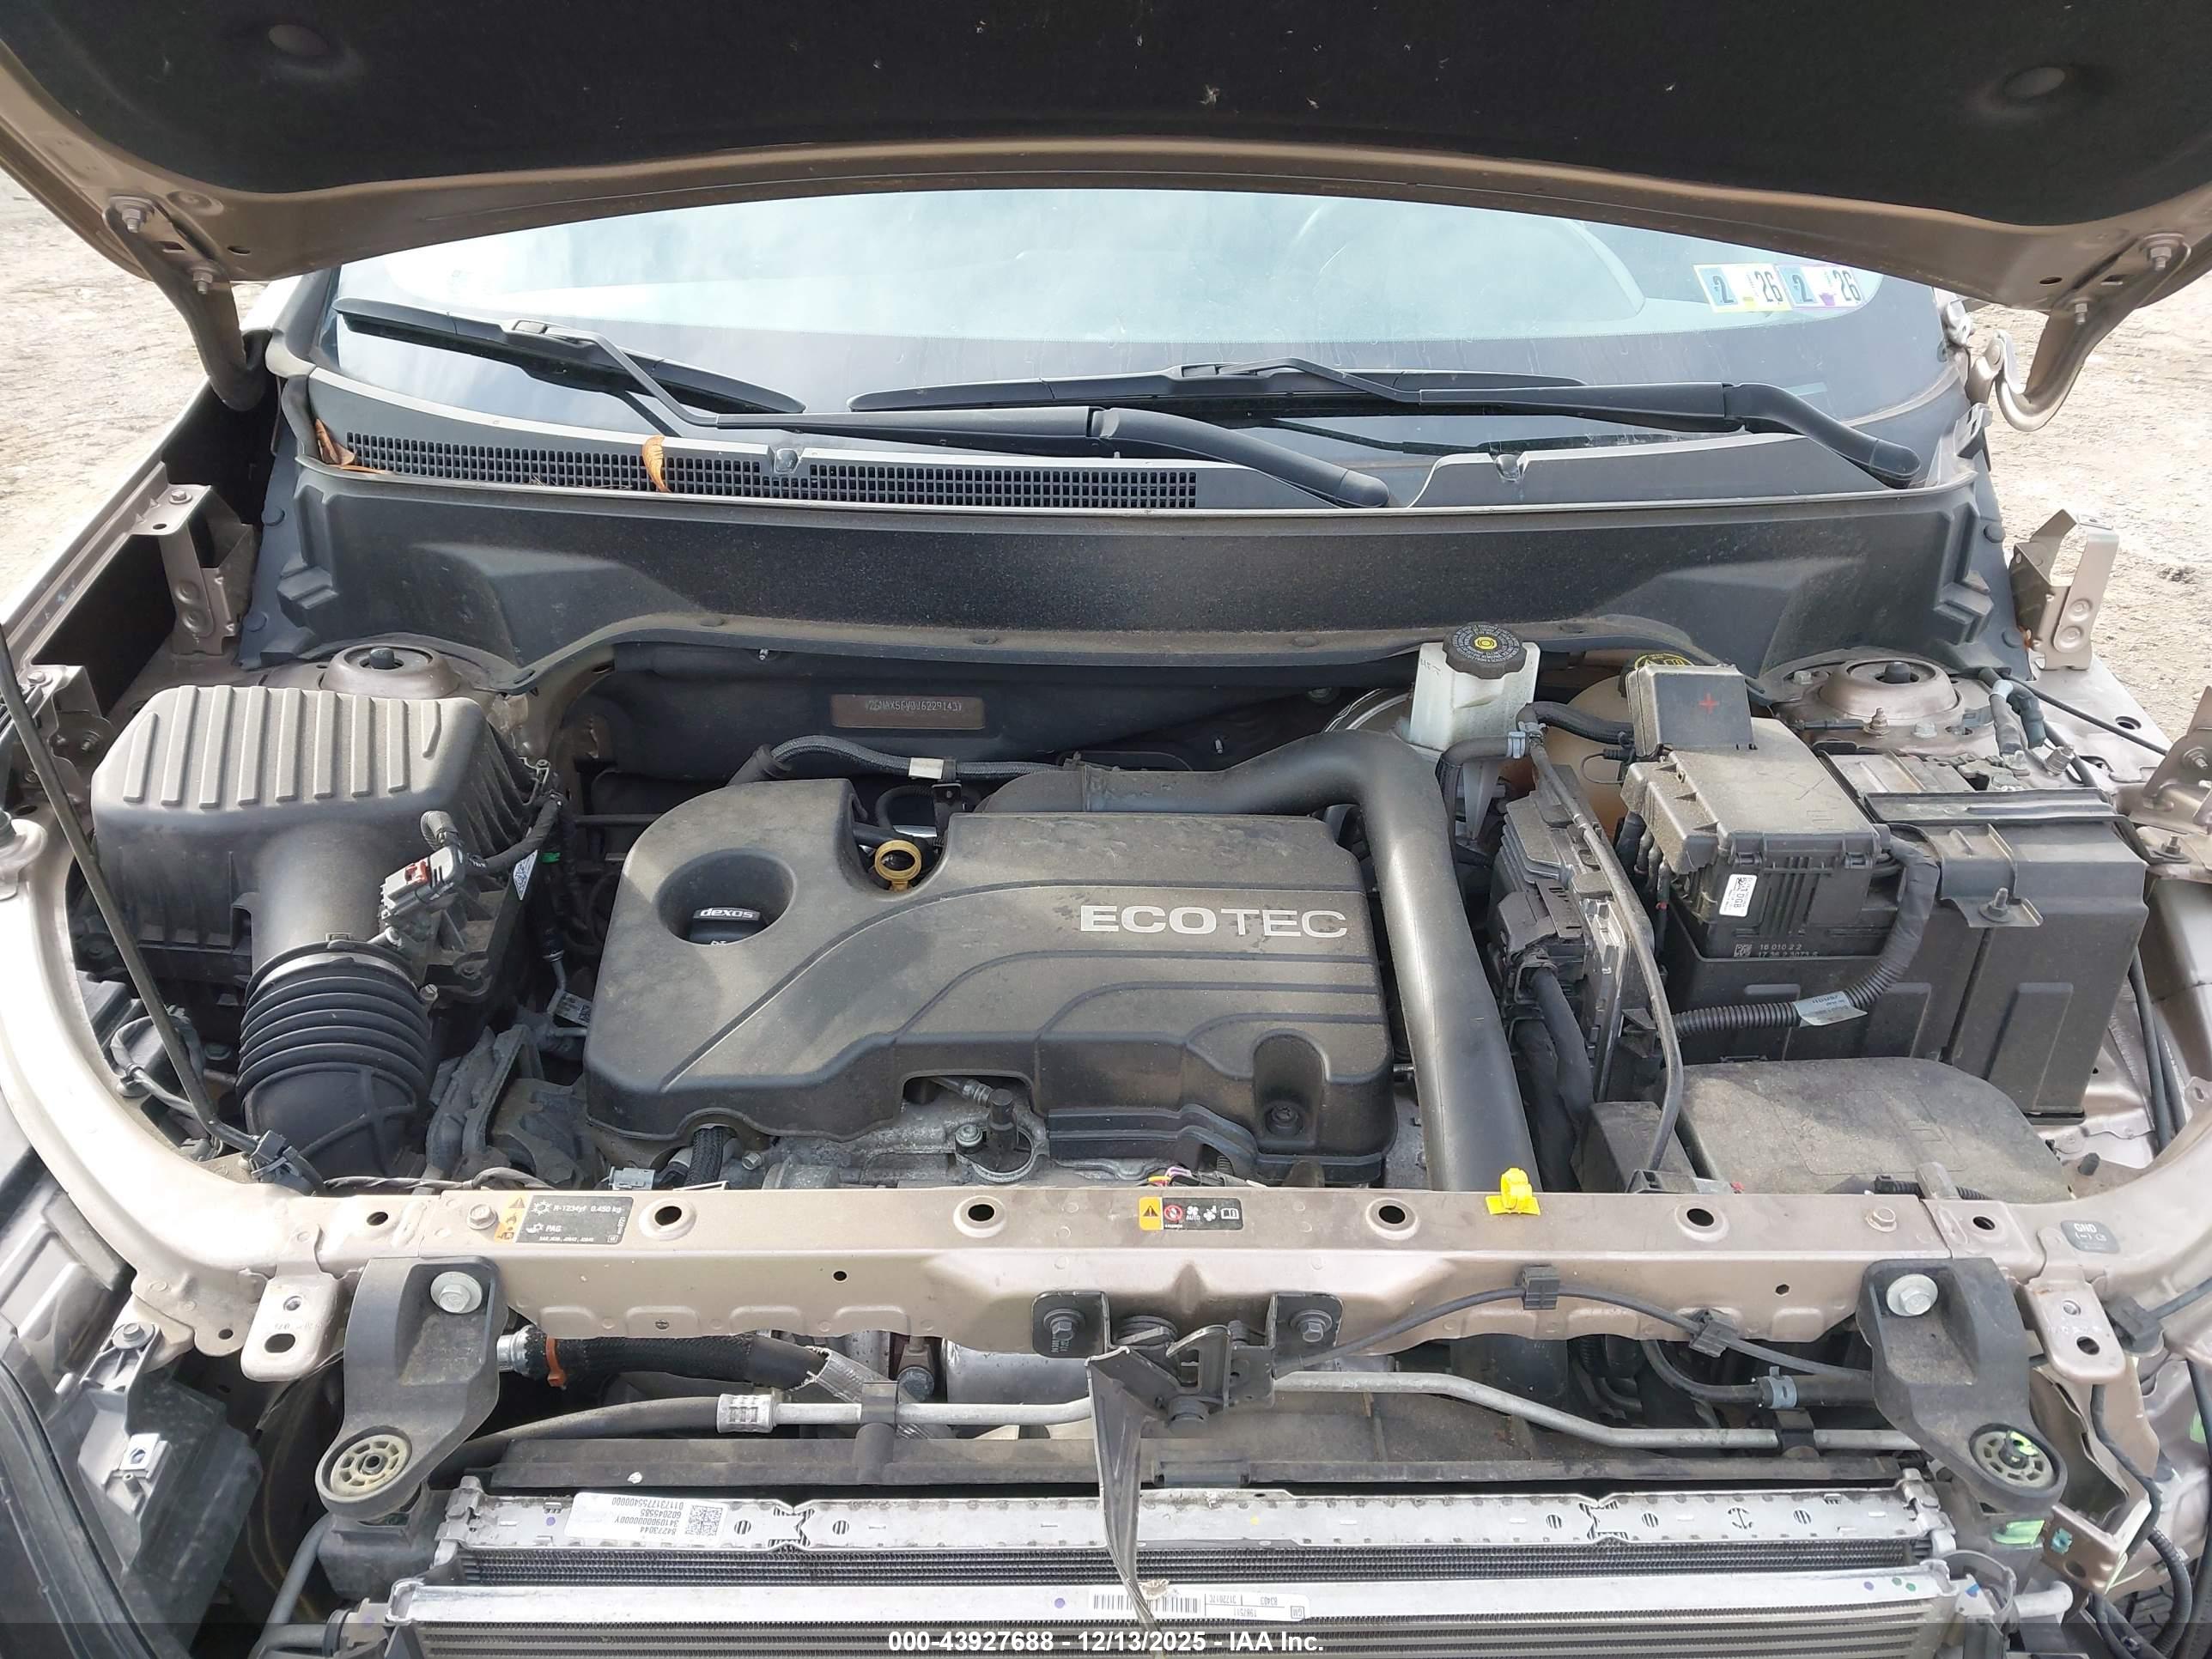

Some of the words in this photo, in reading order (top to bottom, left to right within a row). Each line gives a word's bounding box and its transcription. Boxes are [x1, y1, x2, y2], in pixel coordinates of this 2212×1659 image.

[1712, 275, 1734, 303] 2
[1754, 270, 1784, 302] 26
[1792, 274, 1814, 302] 2
[1832, 270, 1862, 301] 26
[700, 908, 754, 919] dexos
[1079, 905, 1347, 939] ECOTEC
[553, 1204, 586, 1213] R-1234yf
[611, 1206, 623, 1214] kg
[2074, 1223, 2097, 1233] GND
